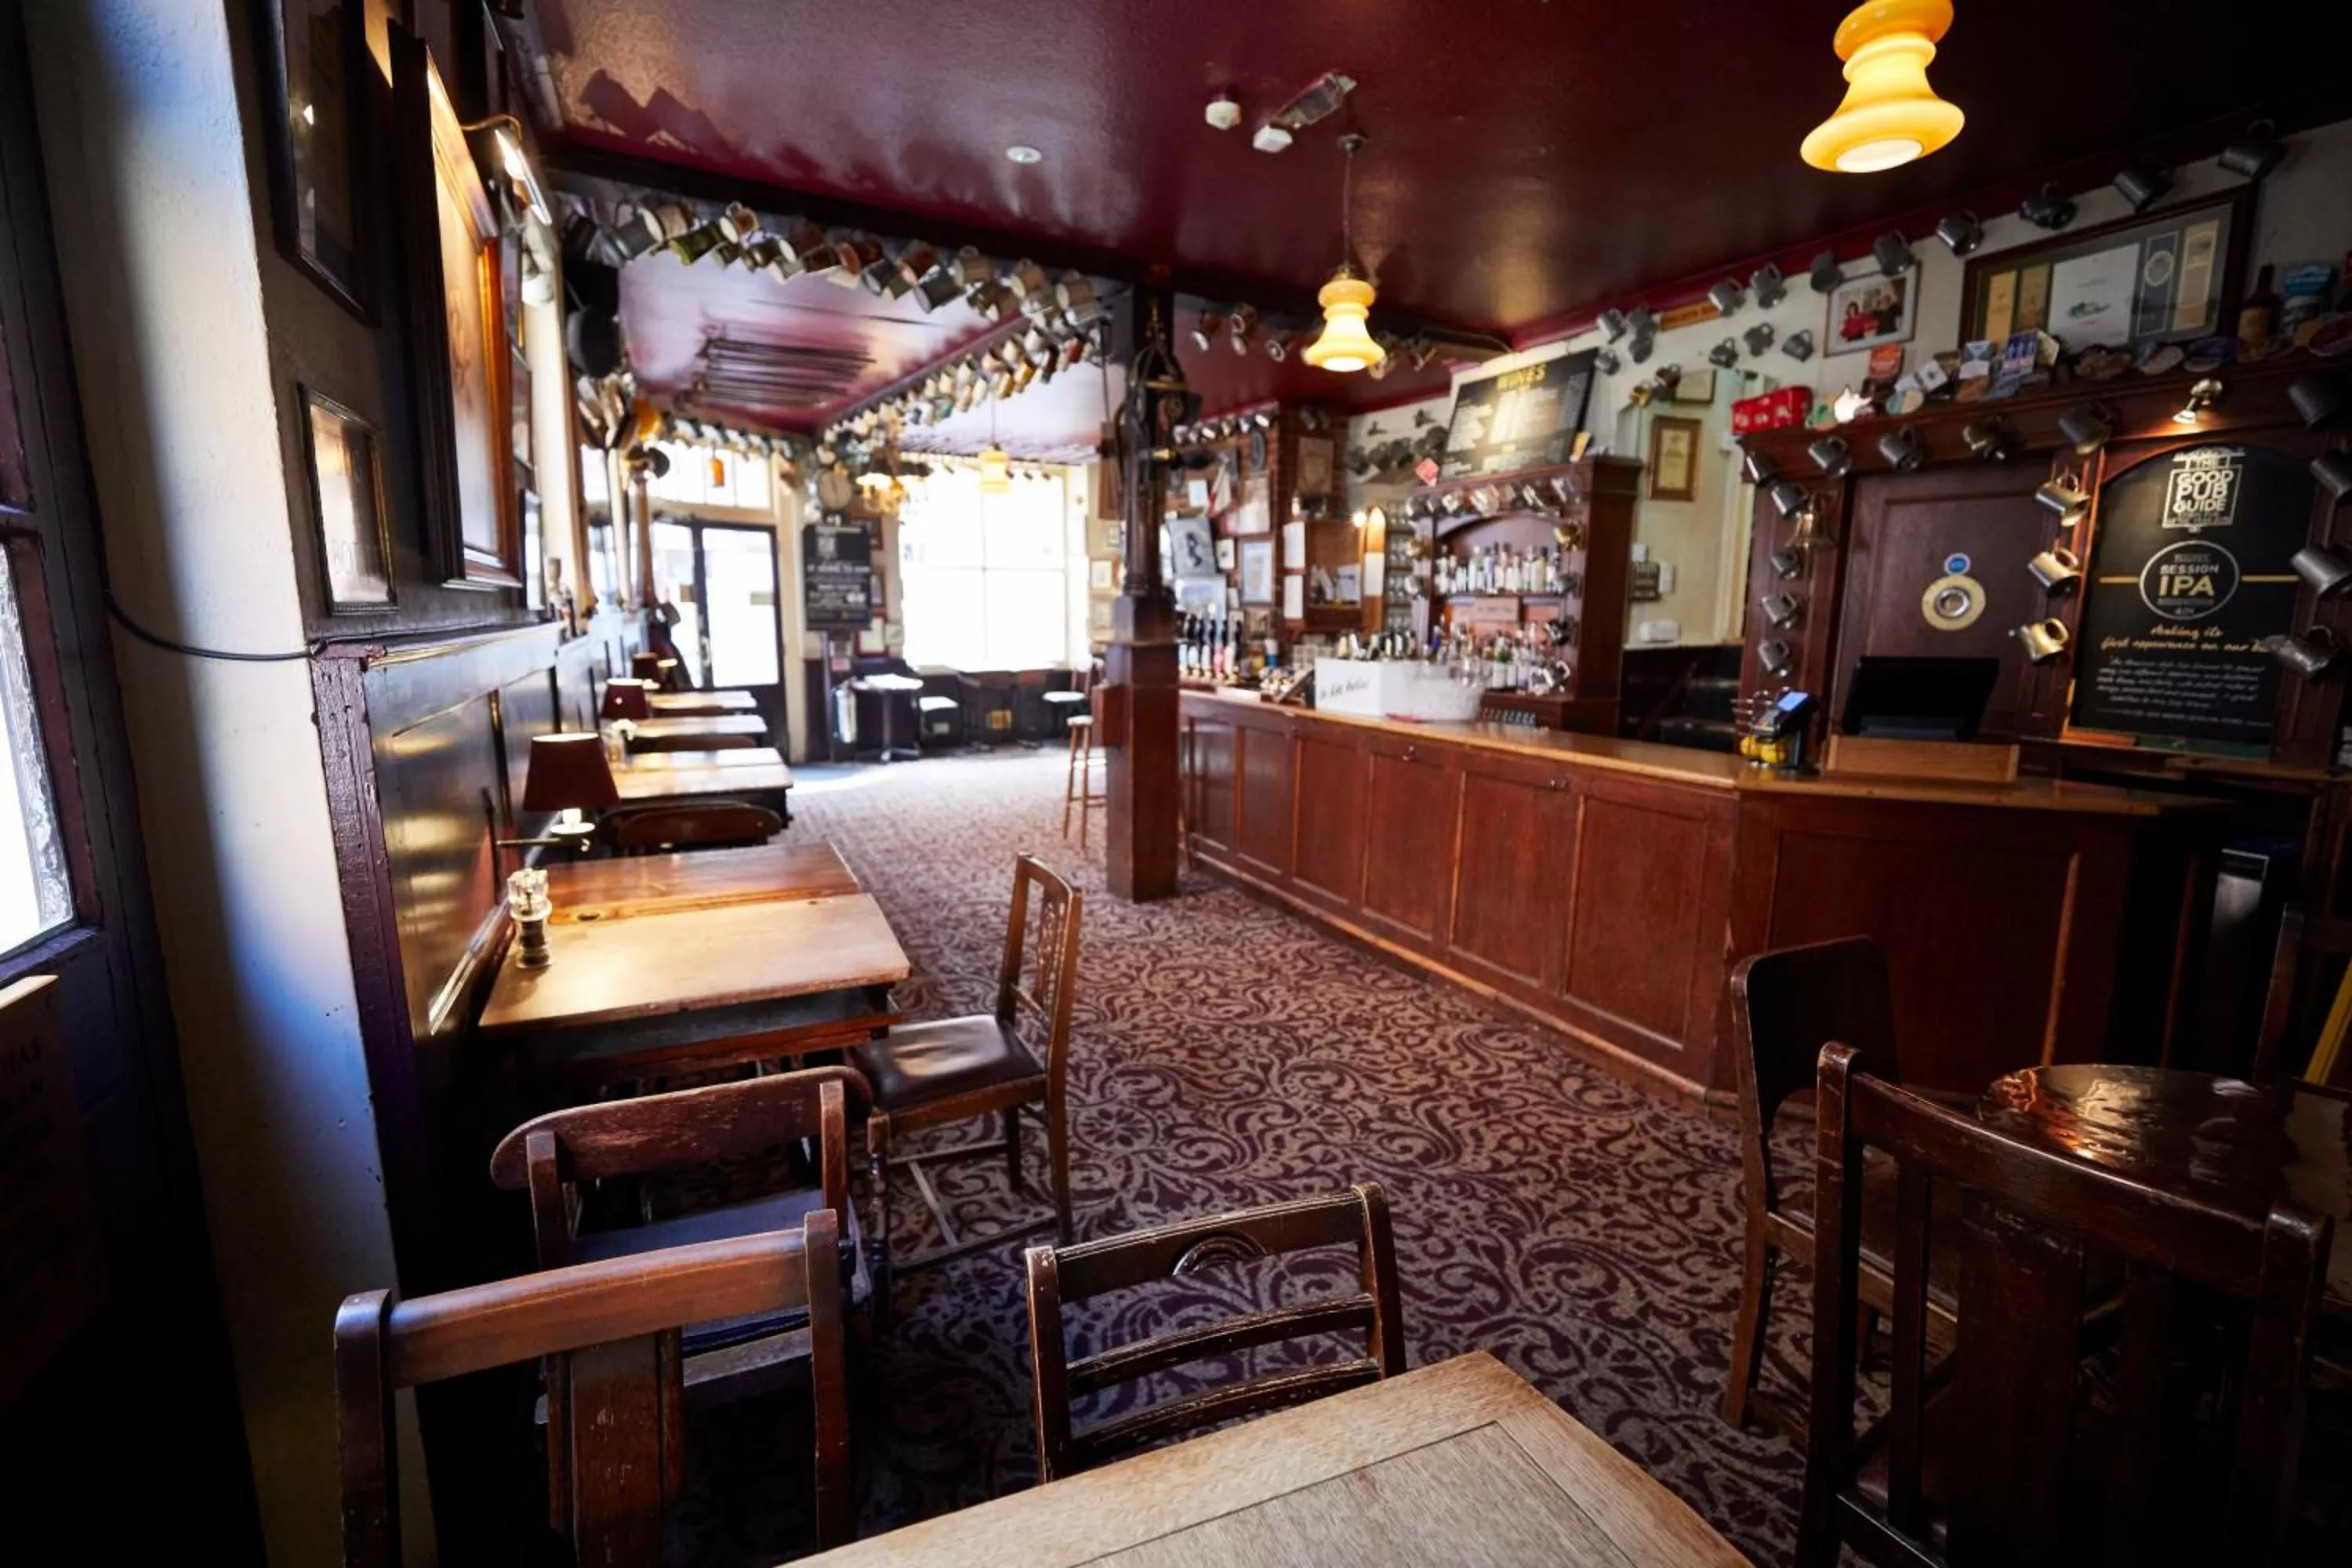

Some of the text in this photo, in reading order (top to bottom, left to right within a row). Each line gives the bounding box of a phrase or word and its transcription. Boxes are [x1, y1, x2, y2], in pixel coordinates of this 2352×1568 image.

[2176, 470, 2234, 487] GOOD
[2176, 481, 2228, 502] PUB
[2172, 499, 2227, 514] GUIDE
[2159, 563, 2220, 575] SESSION
[2158, 573, 2216, 597] IPA
